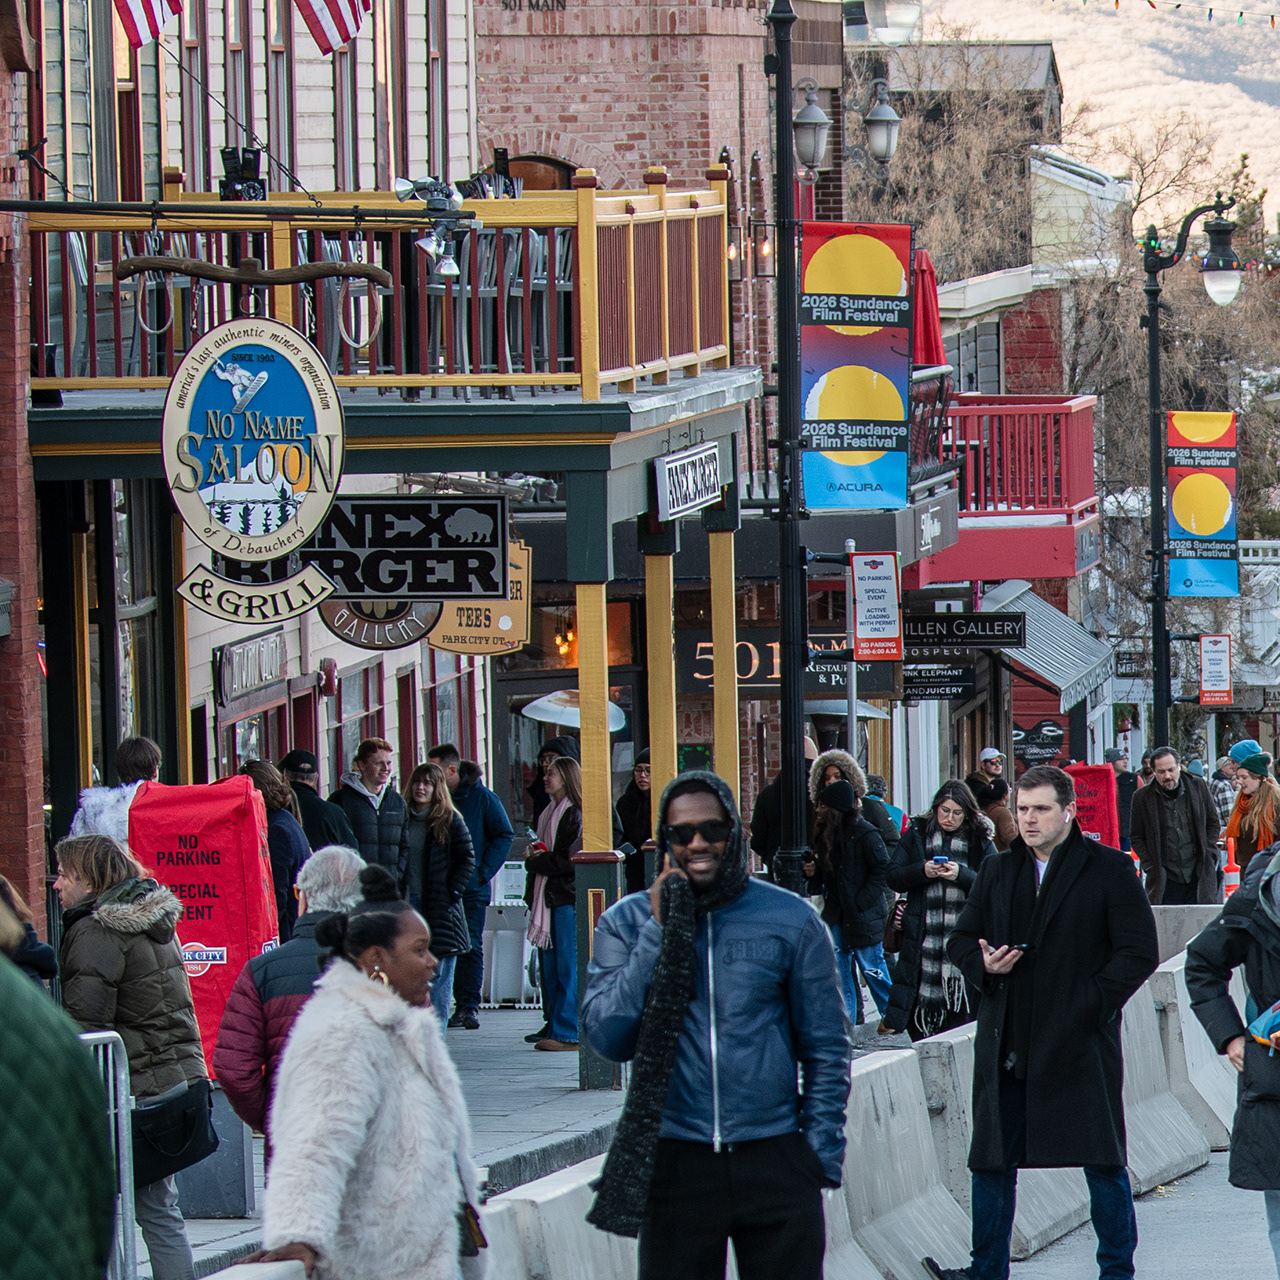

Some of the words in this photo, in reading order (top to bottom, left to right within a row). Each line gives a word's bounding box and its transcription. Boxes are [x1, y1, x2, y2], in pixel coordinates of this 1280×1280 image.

[528, 0, 566, 11] MAIN
[802, 296, 836, 308] 2026
[839, 297, 909, 310] Sundance
[812, 309, 842, 320] Film
[845, 309, 898, 322] Festival
[231, 353, 254, 362] SINCE
[176, 365, 200, 409] america's
[198, 346, 214, 366] last
[213, 326, 265, 349] authentic
[269, 332, 302, 356] miners
[299, 356, 332, 411] organization
[802, 423, 836, 435] 2026
[838, 423, 907, 436] Sundance
[812, 436, 841, 447] Film
[844, 436, 897, 447] Festival
[1168, 449, 1190, 457] 2026
[1191, 449, 1236, 458] Sundance
[170, 431, 339, 493] SALOON
[1174, 457, 1194, 465] Film
[1195, 457, 1230, 466] Festival
[838, 483, 883, 491] ACURA
[301, 503, 450, 549] NEX
[203, 526, 220, 538] of
[222, 525, 306, 555] Debauchery
[1169, 541, 1192, 549] 2026
[1193, 541, 1236, 550] Sundance
[1176, 549, 1196, 557] Film
[1197, 549, 1231, 557] Festival
[456, 607, 492, 628] TEES
[334, 608, 427, 646] GALLERY
[905, 622, 947, 635] ILLEN
[953, 619, 1022, 635] GALLERY
[442, 635, 467, 644] PARK
[468, 636, 490, 645] CITY
[903, 647, 969, 656] ROSPECT
[693, 641, 781, 679] 501
[804, 661, 872, 672] RESTAURNT
[818, 673, 827, 683] &
[831, 674, 847, 686] PU
[178, 835, 199, 850] NO
[156, 851, 221, 866] PARKING
[171, 884, 221, 900] PECIAL
[179, 905, 214, 921] VENT
[196, 951, 223, 961] CITY
